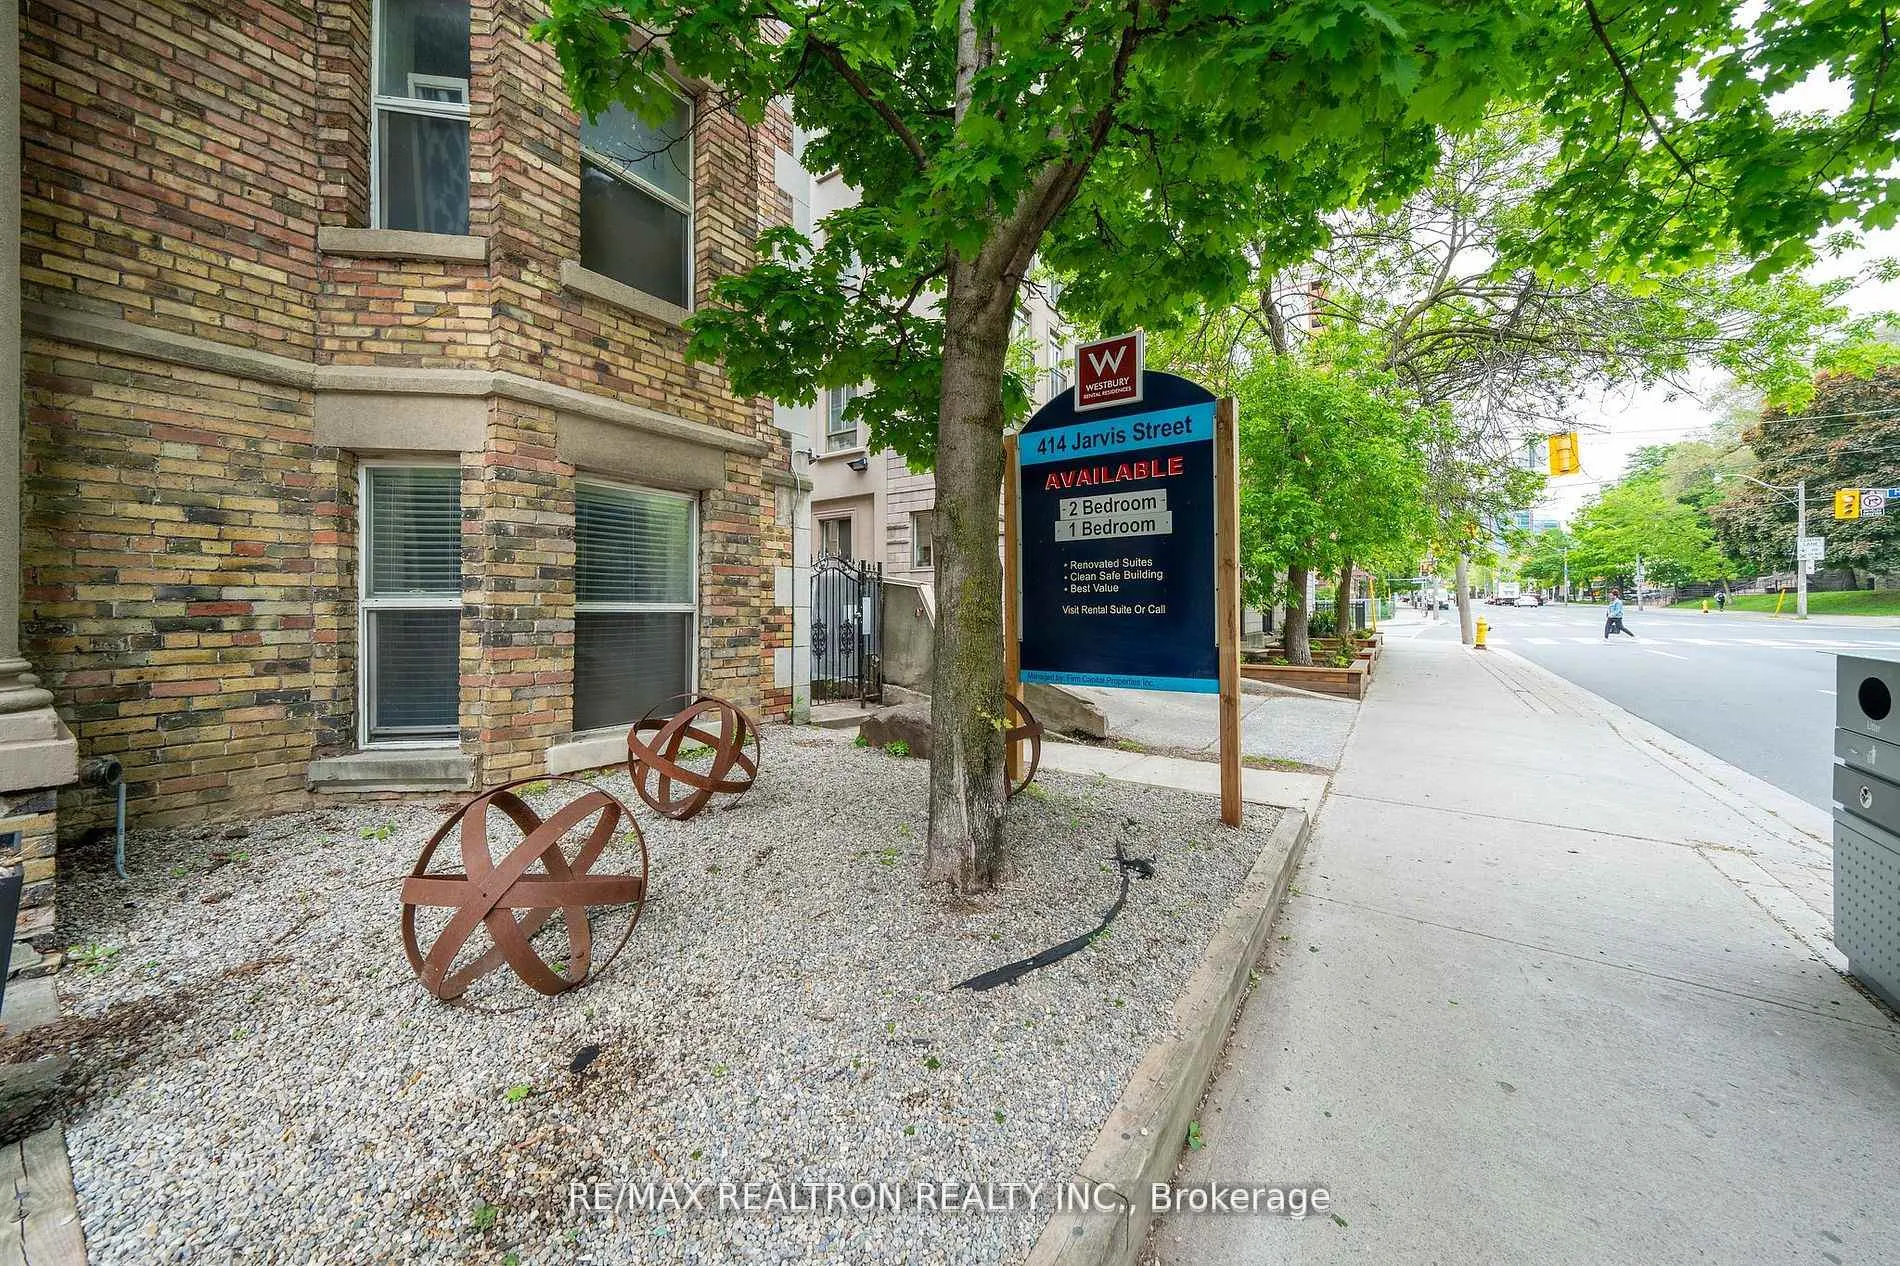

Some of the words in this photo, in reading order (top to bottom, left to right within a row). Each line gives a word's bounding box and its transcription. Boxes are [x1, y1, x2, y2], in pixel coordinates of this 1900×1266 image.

[1088, 345, 1127, 376] W
[1085, 376, 1130, 392] WESTBURY
[1037, 435, 1066, 455] 414
[1071, 427, 1126, 449] Jarvis
[1132, 416, 1192, 441] Street
[1045, 456, 1184, 490] AVAILABLE
[1068, 501, 1079, 517] 2
[1082, 496, 1158, 516] Bedroom
[1068, 523, 1077, 538] 1
[1082, 518, 1156, 536] Bedroom
[1070, 559, 1120, 570] Renovated
[1122, 557, 1153, 568] Suites
[1070, 572, 1097, 582] Clean
[1099, 570, 1121, 581] Safe
[1123, 570, 1164, 581] Building
[1070, 584, 1091, 593] Best
[1093, 583, 1120, 593] Value
[1062, 605, 1080, 615] Visit
[1081, 605, 1108, 615] Rental
[1109, 604, 1132, 614] Suite
[1134, 604, 1146, 614] Or
[1147, 604, 1166, 614] Call
